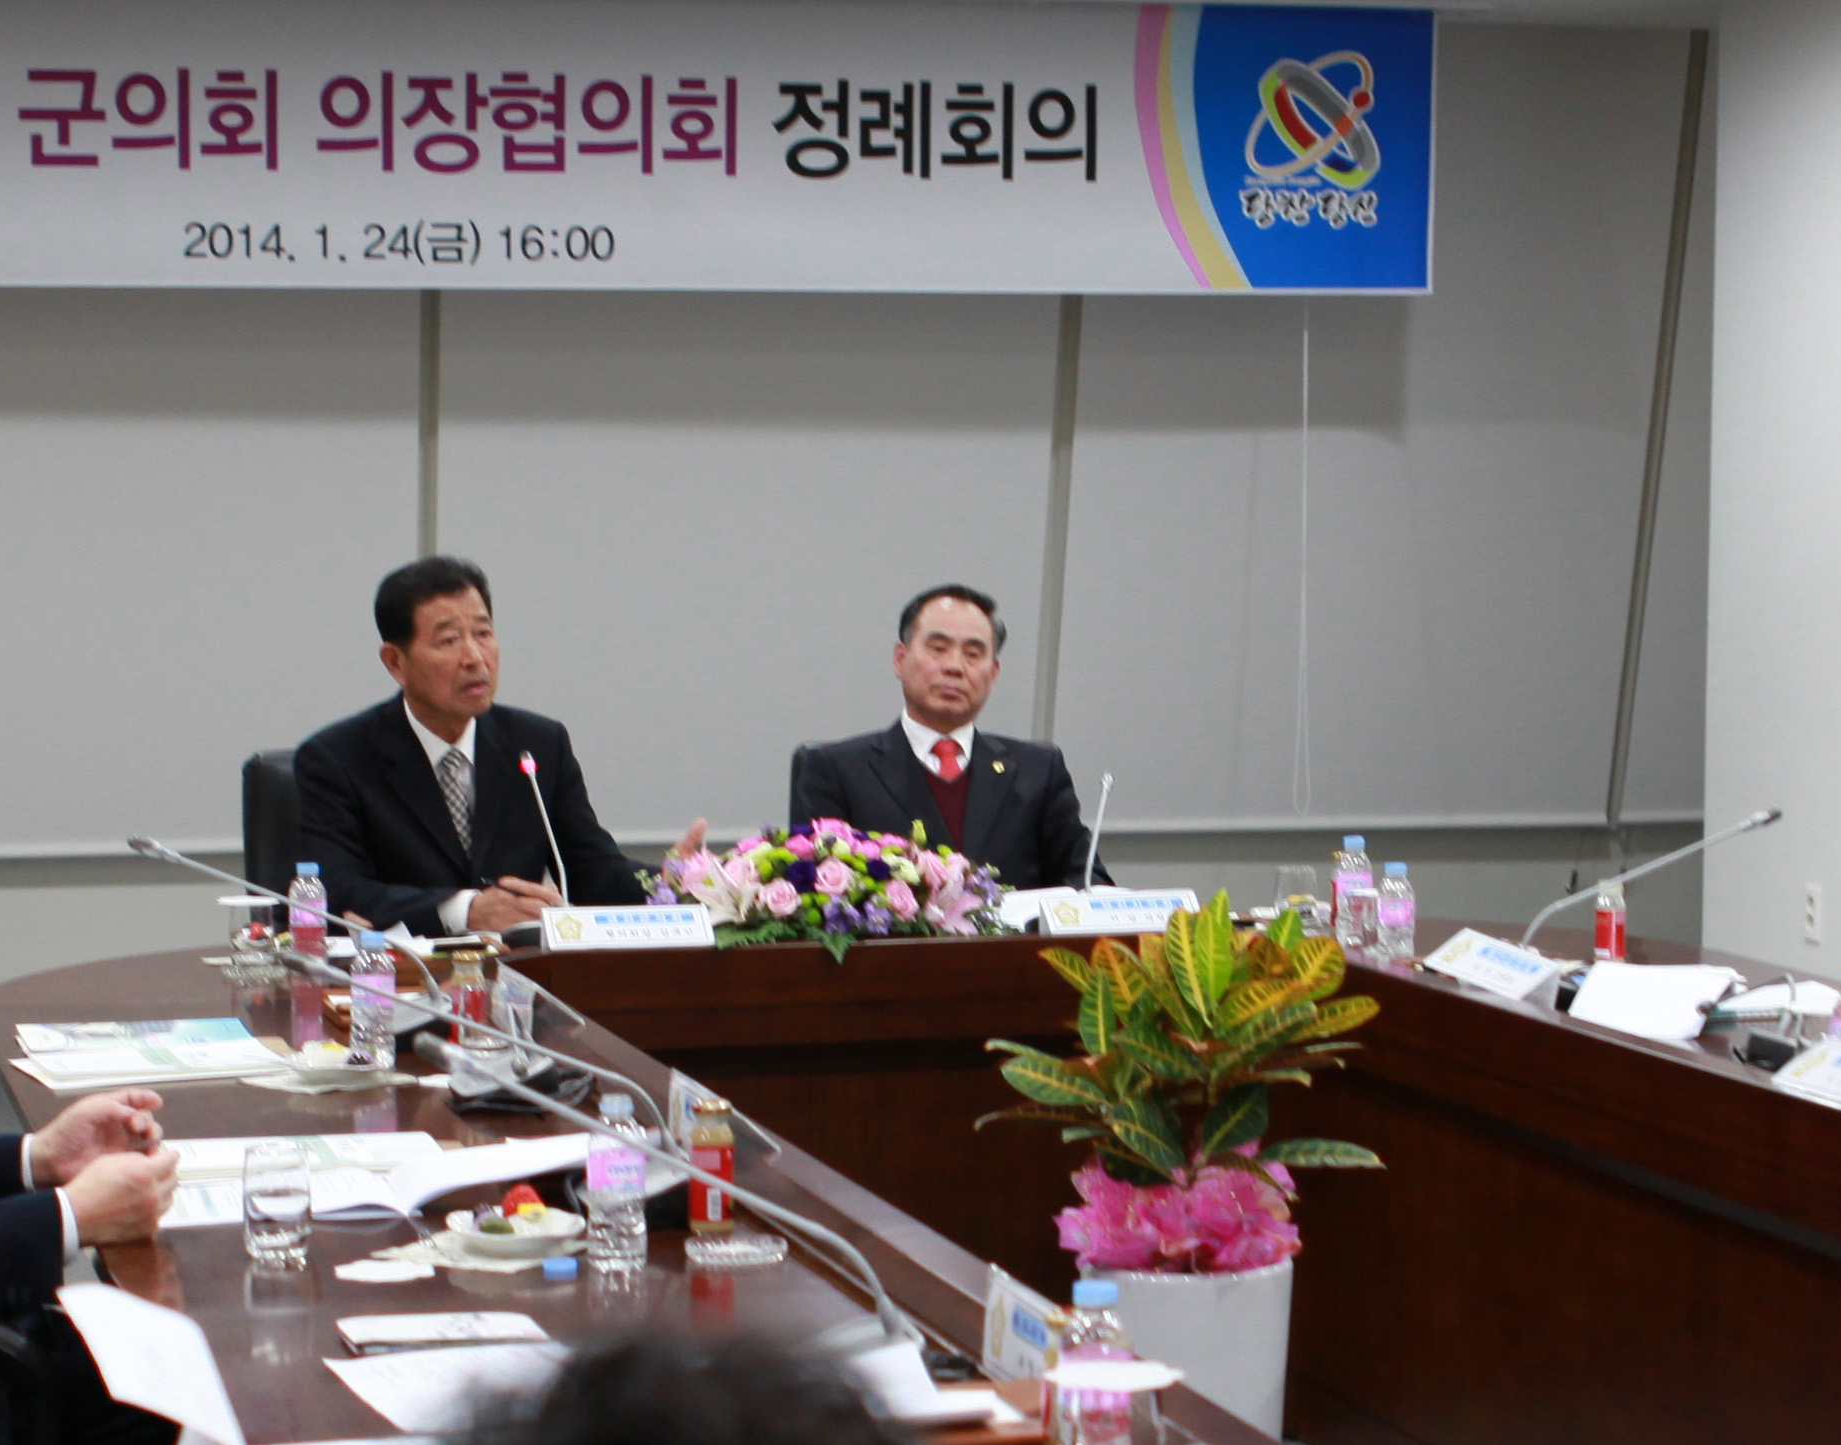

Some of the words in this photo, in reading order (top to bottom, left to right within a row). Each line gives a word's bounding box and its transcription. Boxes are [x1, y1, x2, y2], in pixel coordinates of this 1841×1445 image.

[314, 70, 739, 176] 의장협의회
[772, 78, 1099, 183] 정례회의
[182, 220, 297, 262] 2014.
[313, 223, 348, 264] 1.
[362, 219, 483, 267] 24(금)
[498, 223, 617, 263] 16:00
